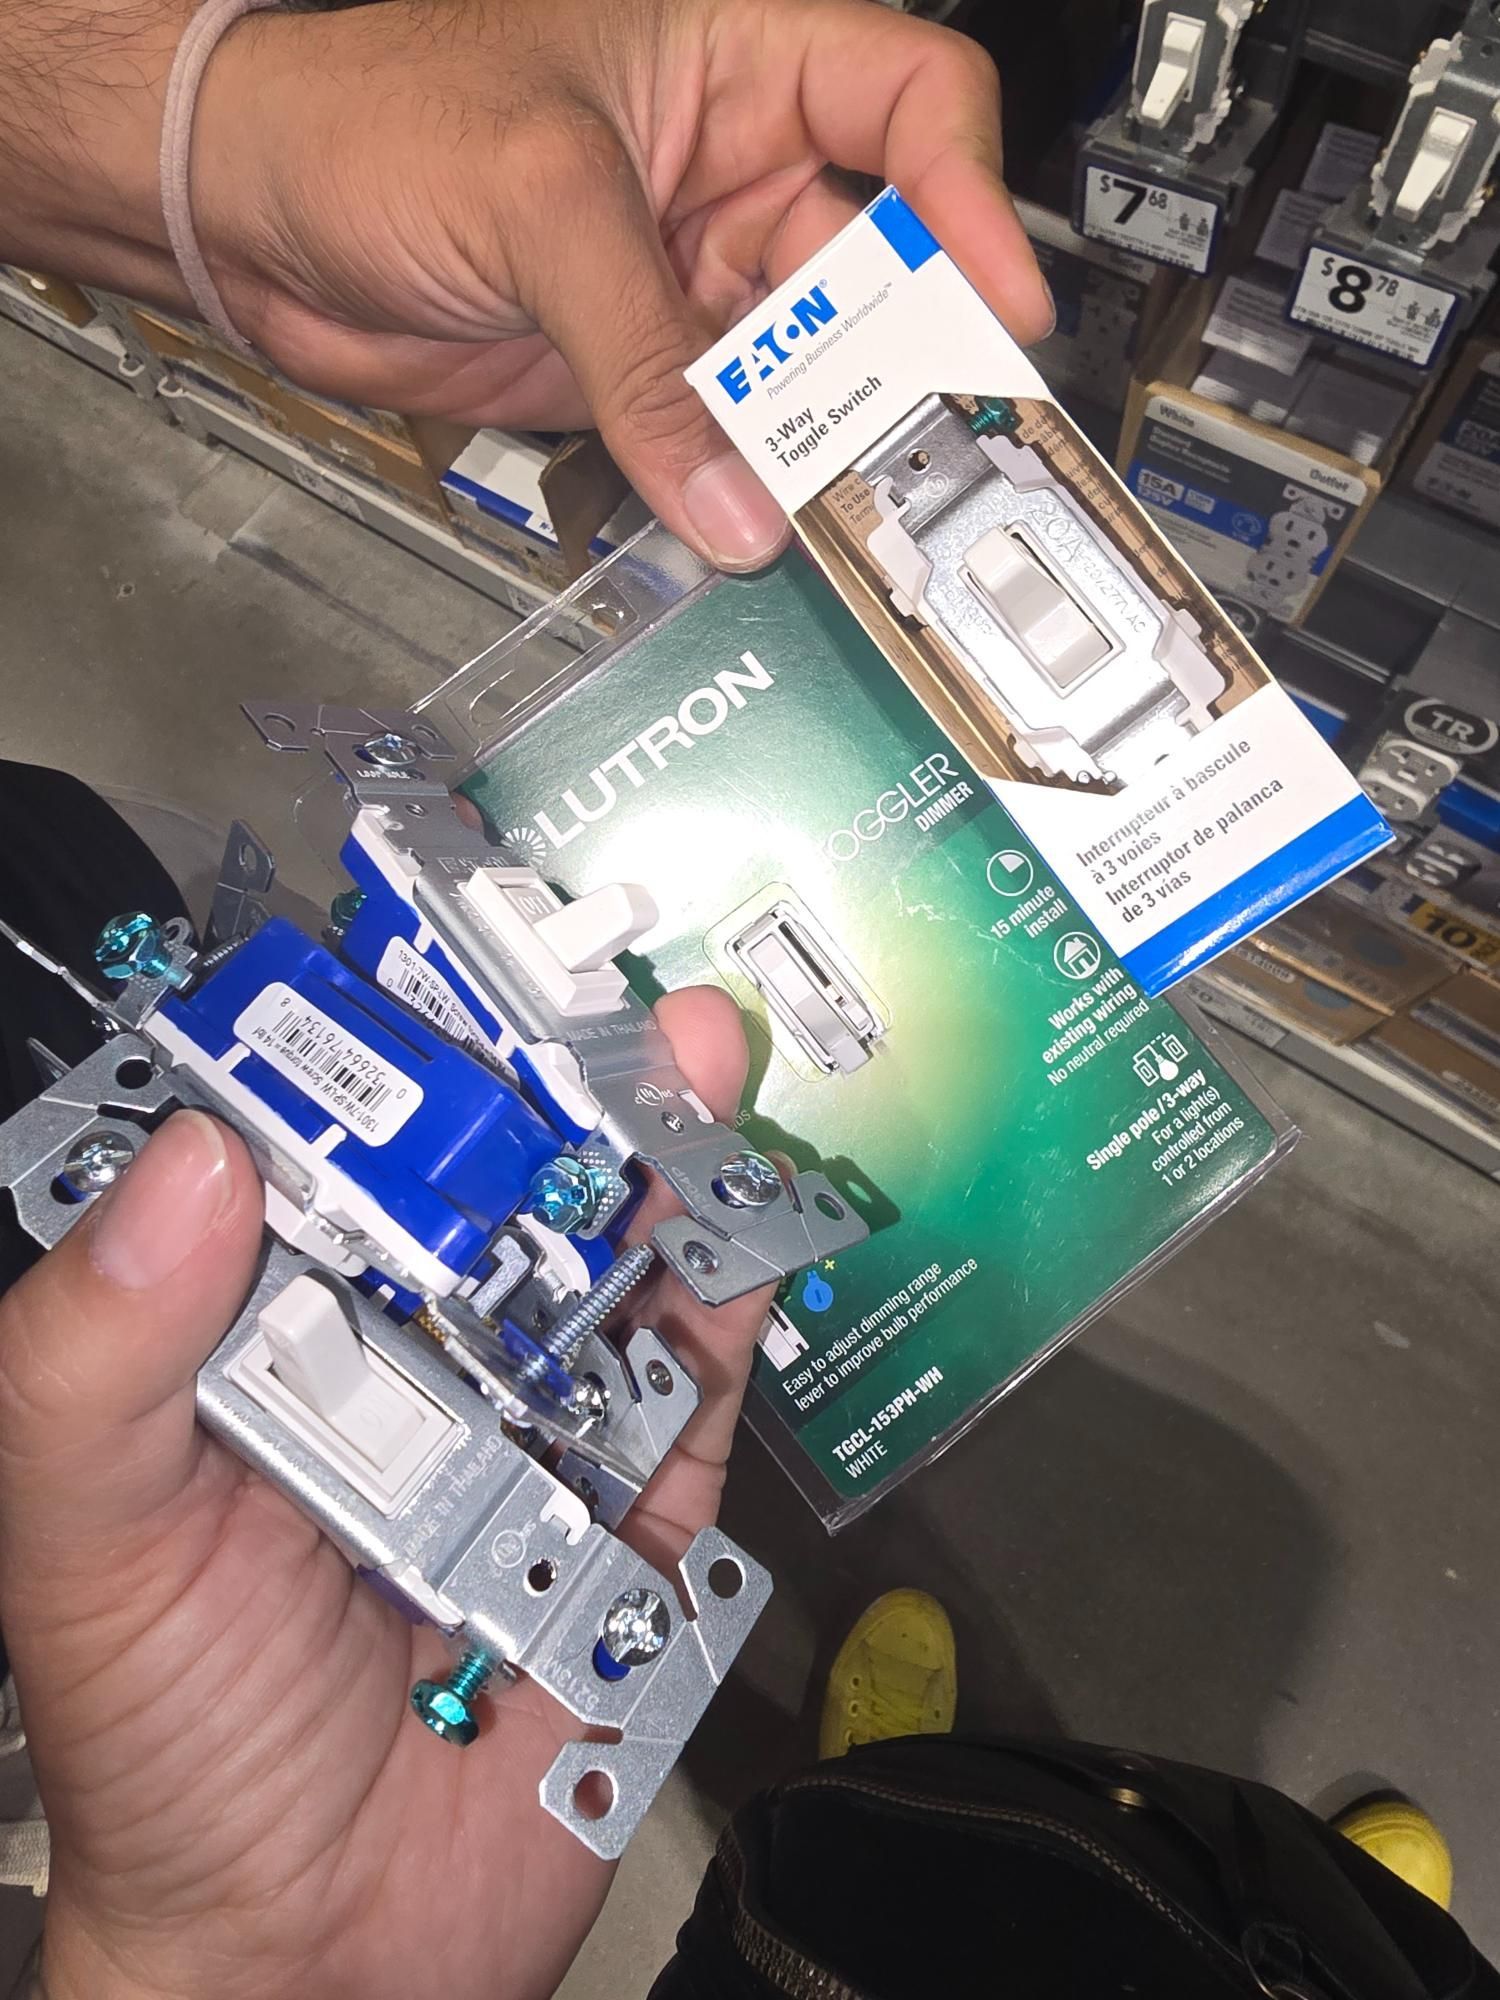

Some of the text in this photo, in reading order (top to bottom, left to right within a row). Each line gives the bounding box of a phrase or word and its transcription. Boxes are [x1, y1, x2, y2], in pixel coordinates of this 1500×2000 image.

[715, 284, 839, 405] EATON
[766, 361, 807, 401] Powering
[804, 329, 844, 366] Business
[764, 406, 816, 453] 3-Way
[776, 374, 883, 468] Toggle Switch
[1141, 471, 1177, 497] 15A
[532, 649, 776, 851] LUTRON
[914, 780, 975, 834] DIMMER
[1076, 738, 1252, 867] Interrupteur à bascule
[1090, 829, 1162, 885] à 3 voies
[1105, 776, 1285, 906] Interruptor de palanca
[990, 883, 1056, 940] 15 minute
[1023, 898, 1069, 940] install
[1121, 869, 1193, 924] de 3 vías
[304, 1015, 345, 1048] 76134
[1040, 983, 1138, 1066] existing wiring
[1047, 966, 1125, 1032] Works with
[347, 1053, 388, 1086] 32664
[1046, 999, 1151, 1087] No neutral required
[1151, 1085, 1221, 1146] For a light(s)
[1151, 1101, 1233, 1174] controlled from
[1086, 1129, 1133, 1172] Single
[1160, 1114, 1245, 1188] 1 or 2 locations
[781, 1261, 942, 1397] Easy to adjust dimming range
[793, 1256, 979, 1412] lever to improve bulb performance
[831, 1365, 945, 1463] TGCL-153PH-WH
[844, 1439, 889, 1479] WHITE
